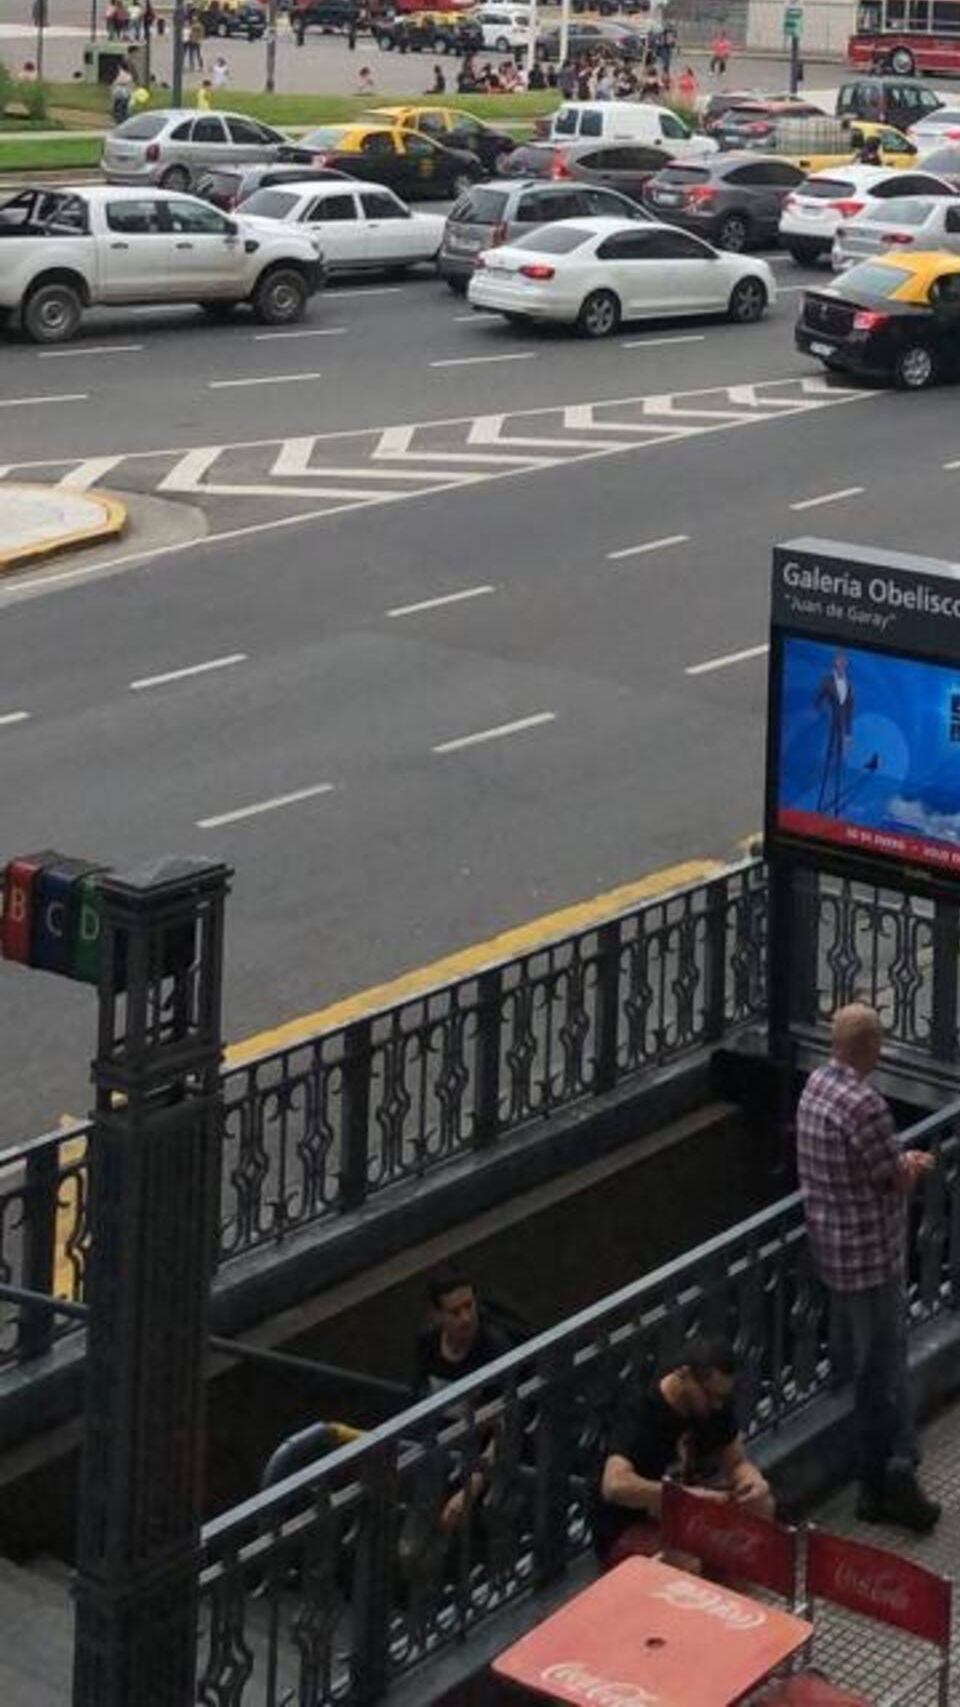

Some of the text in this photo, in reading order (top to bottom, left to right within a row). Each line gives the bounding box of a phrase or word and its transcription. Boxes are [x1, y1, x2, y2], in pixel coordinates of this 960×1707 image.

[783, 562, 862, 598] Galeria
[826, 602, 844, 619] de
[9, 887, 100, 940] B C D
